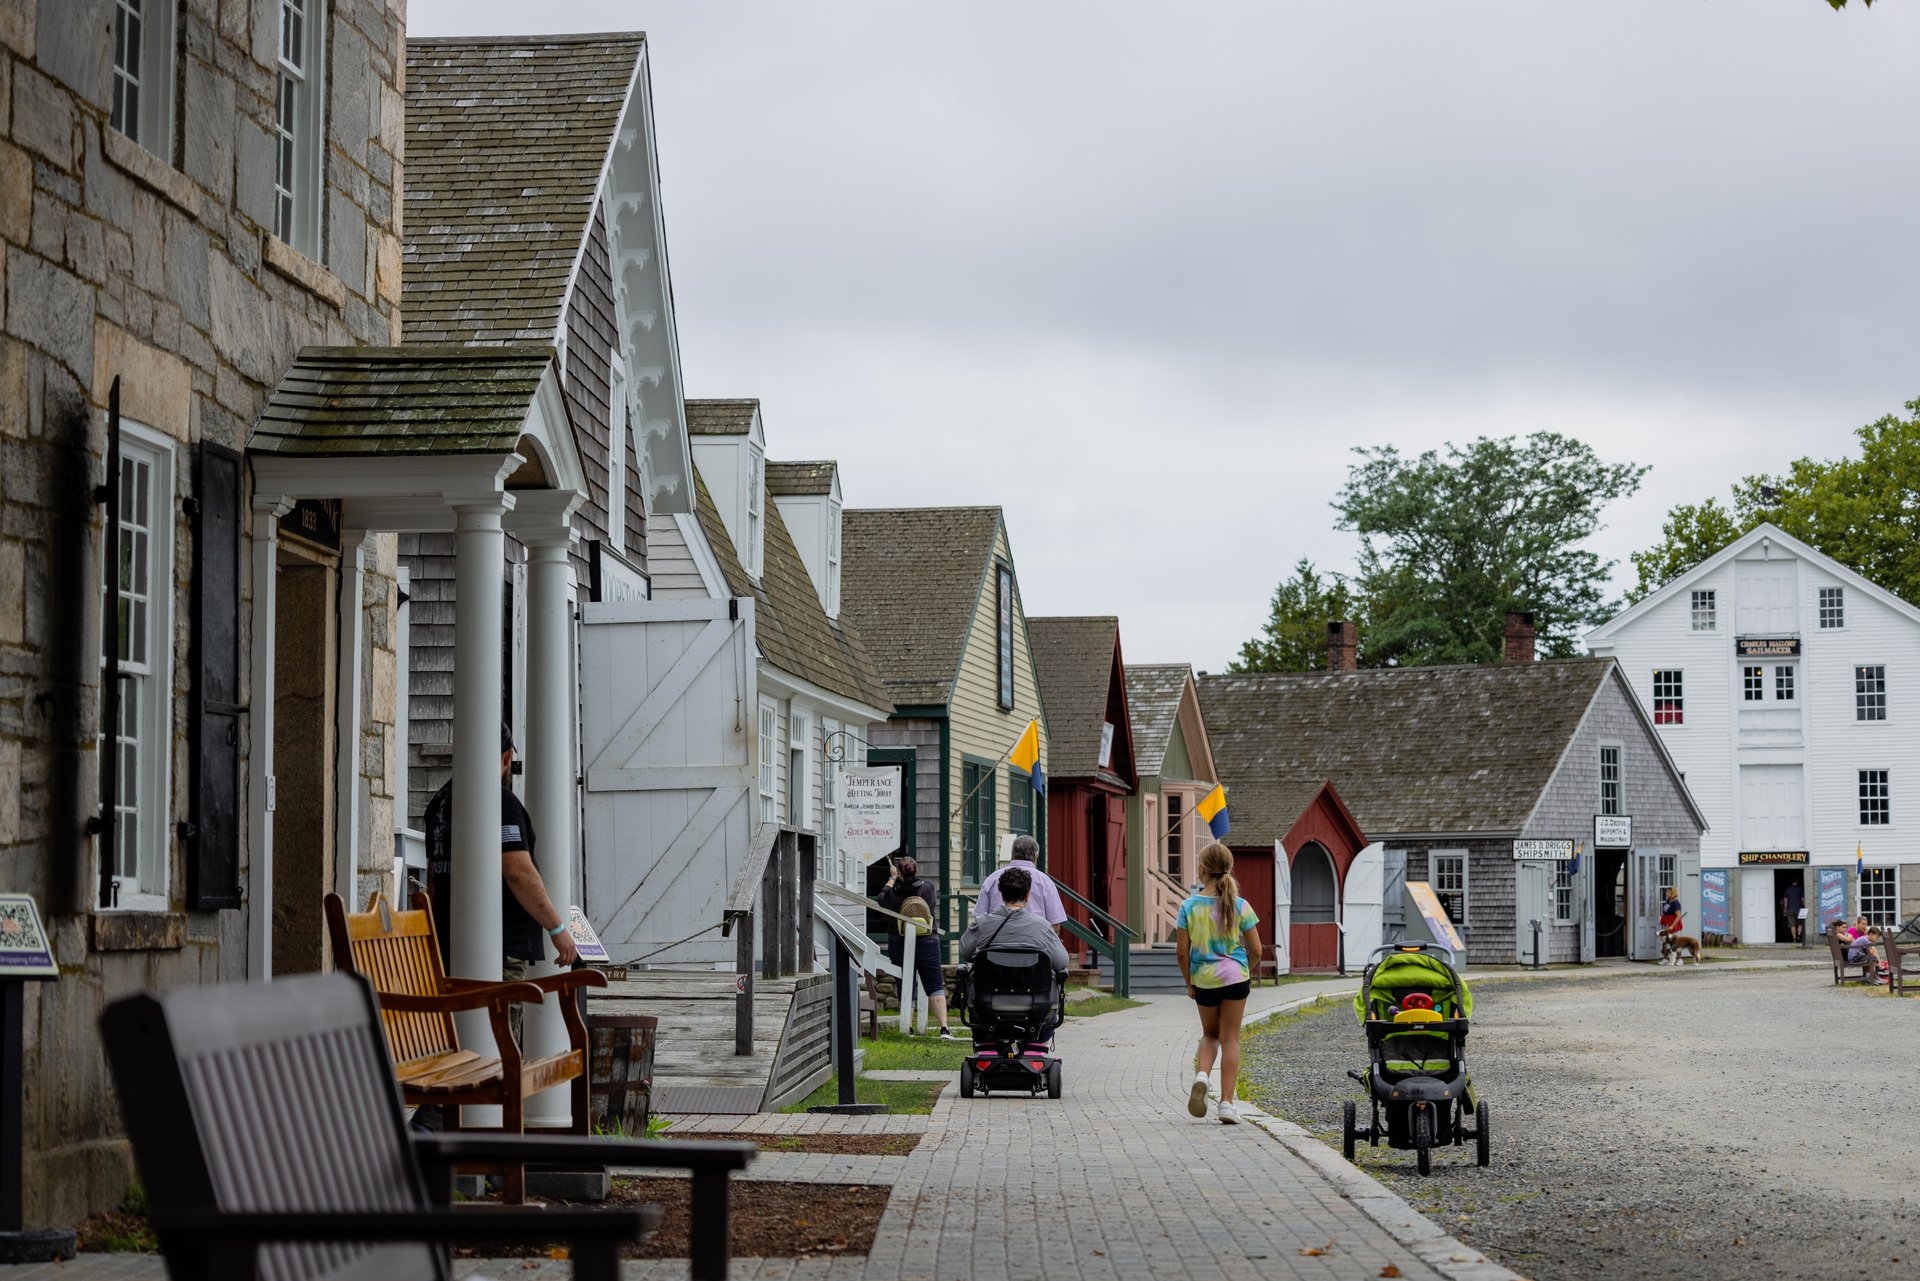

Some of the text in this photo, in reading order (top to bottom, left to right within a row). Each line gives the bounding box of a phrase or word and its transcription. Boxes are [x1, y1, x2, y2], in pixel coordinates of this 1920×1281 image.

[302, 508, 316, 532] 1833
[846, 775, 892, 786] TEMPERANCE
[847, 788, 892, 798] MEETING TODAY
[1515, 841, 1537, 850] JAMES
[1545, 841, 1571, 850] DRIGGS
[1741, 854, 1760, 864] SHIP
[1760, 853, 1807, 862] CHANDLERY
[28, 956, 48, 964] Office
